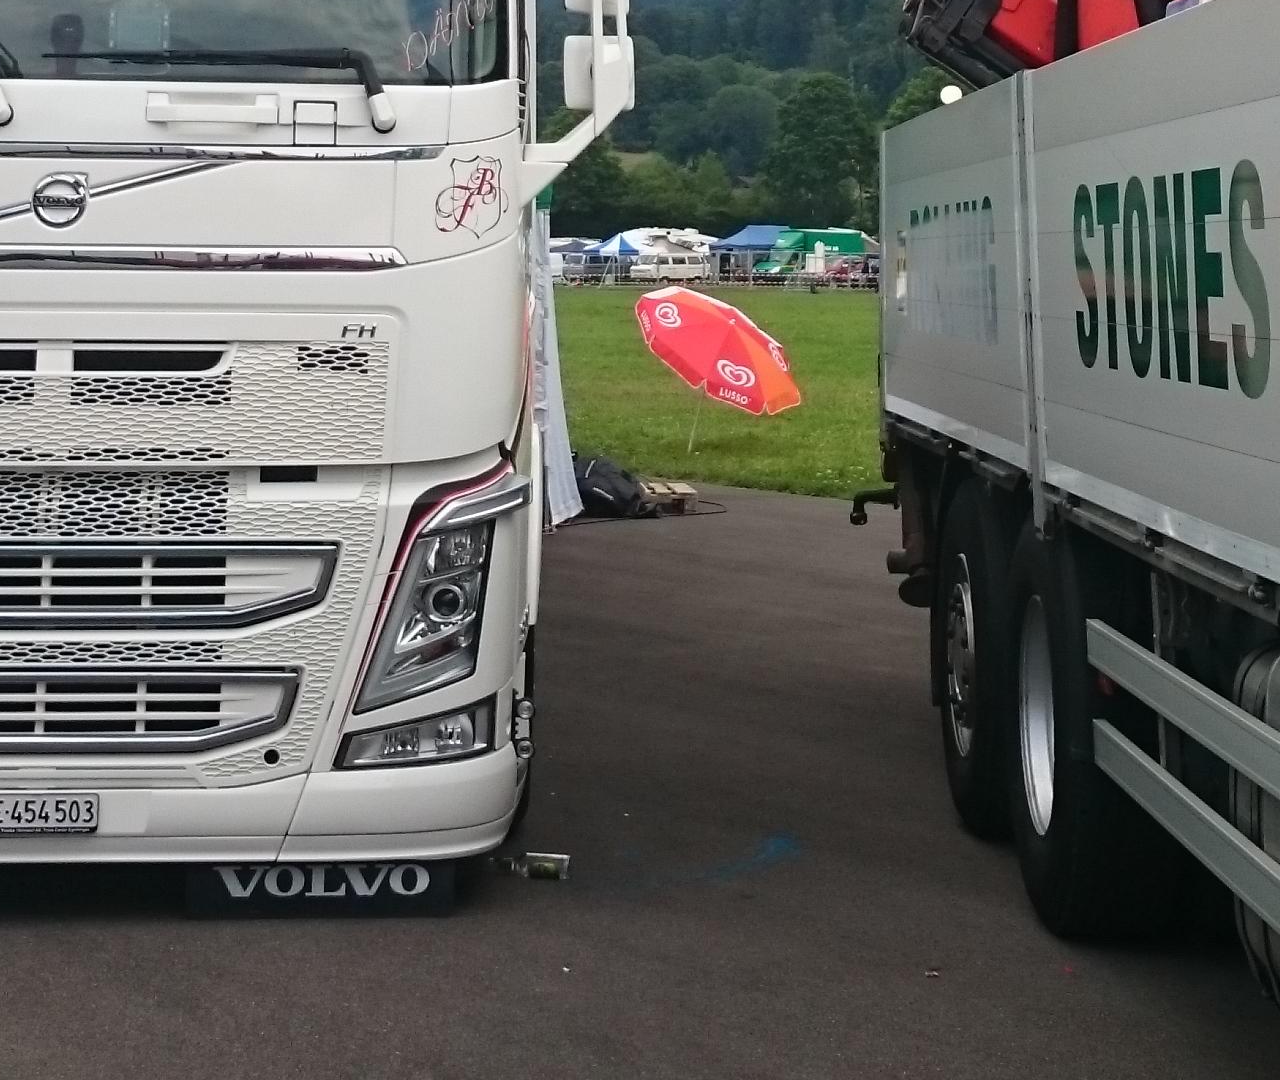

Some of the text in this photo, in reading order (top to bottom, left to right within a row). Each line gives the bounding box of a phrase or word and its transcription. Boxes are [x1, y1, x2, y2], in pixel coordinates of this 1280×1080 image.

[1073, 158, 1271, 400] STONES
[341, 323, 377, 338] FH
[719, 386, 749, 405] LUSSO
[212, 863, 430, 898] VOLVO
